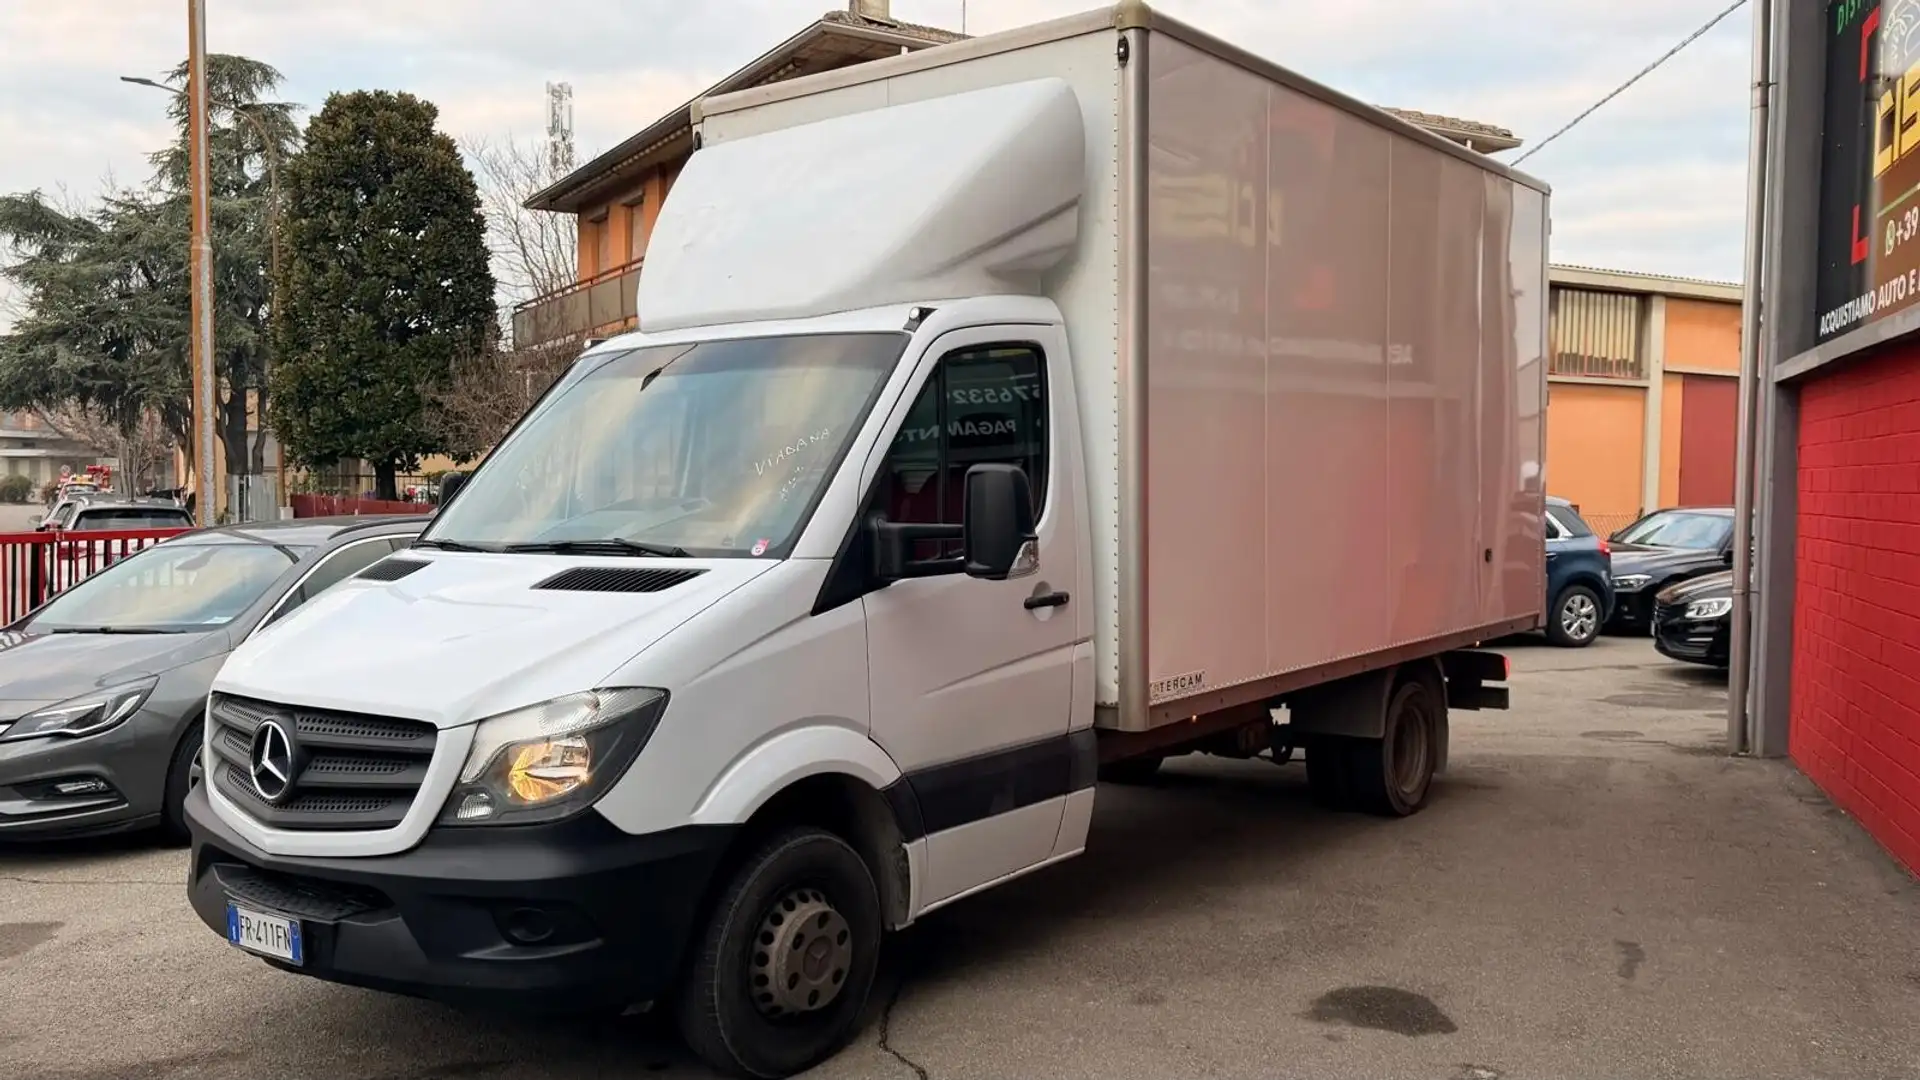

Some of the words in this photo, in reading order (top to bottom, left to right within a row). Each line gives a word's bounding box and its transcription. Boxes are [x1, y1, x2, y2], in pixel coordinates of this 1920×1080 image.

[1820, 290, 1876, 336] ACQUISTIAMO
[1877, 274, 1906, 310] AUTO
[1909, 268, 1917, 296] E
